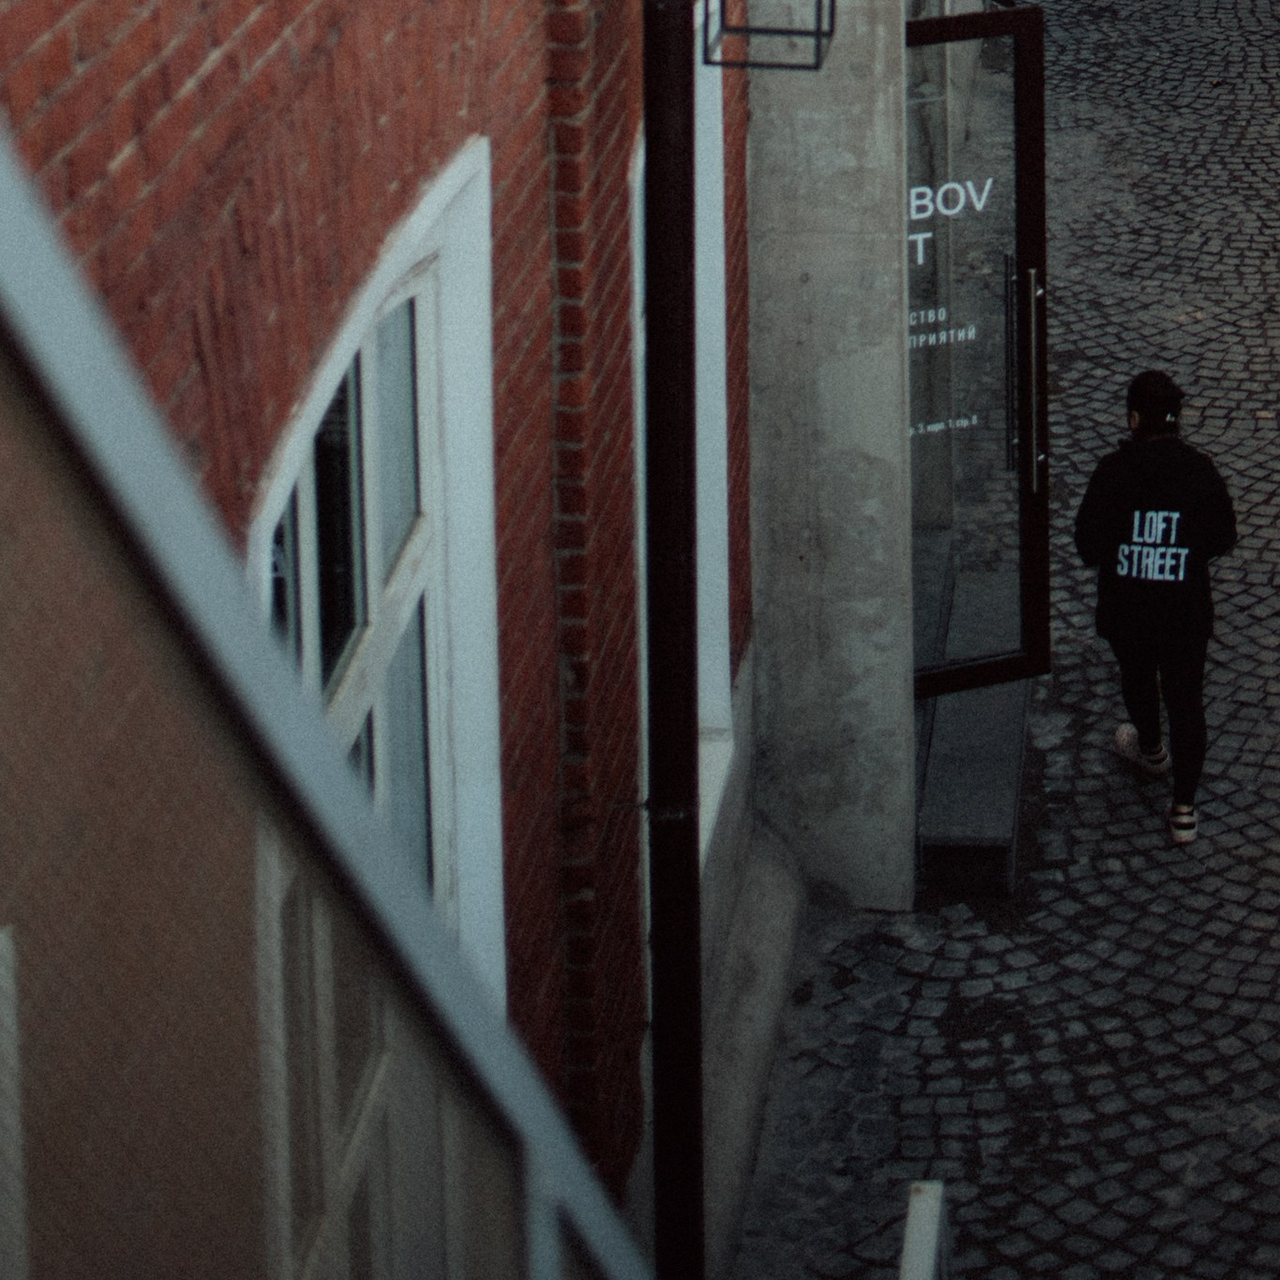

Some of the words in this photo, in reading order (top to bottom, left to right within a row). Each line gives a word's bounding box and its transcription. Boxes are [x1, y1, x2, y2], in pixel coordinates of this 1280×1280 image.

[910, 177, 993, 220] BOV
[909, 307, 946, 326] СТВО
[1132, 510, 1180, 544] LOFT
[1117, 544, 1189, 580] STREET
